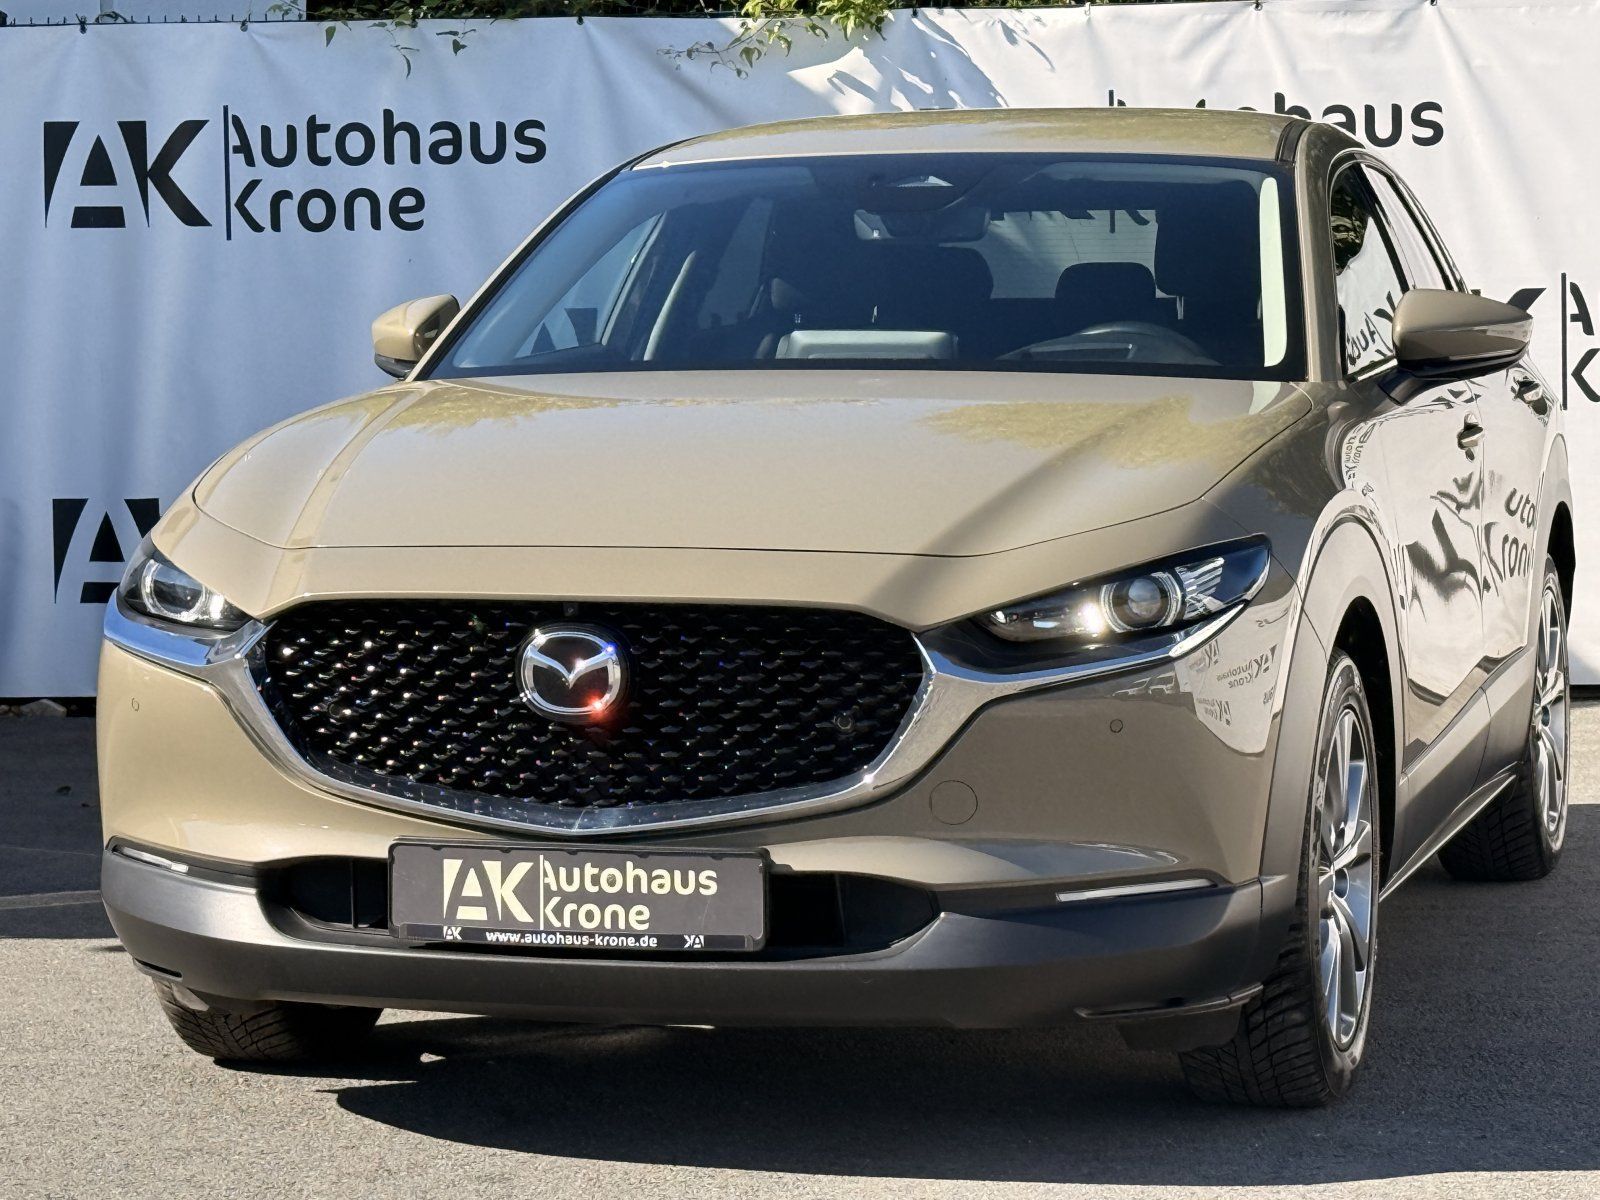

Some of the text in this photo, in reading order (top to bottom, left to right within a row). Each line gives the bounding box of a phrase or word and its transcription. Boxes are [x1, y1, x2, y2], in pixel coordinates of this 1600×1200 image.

[231, 108, 547, 168] Autohaus
[43, 120, 213, 228] AK
[232, 178, 426, 233] Krone
[52, 498, 161, 604] A
[443, 858, 534, 923] AK
[543, 859, 718, 896] Autohaus
[486, 930, 658, 948] www.autohaus-krone.de
[544, 895, 650, 931] Krone
